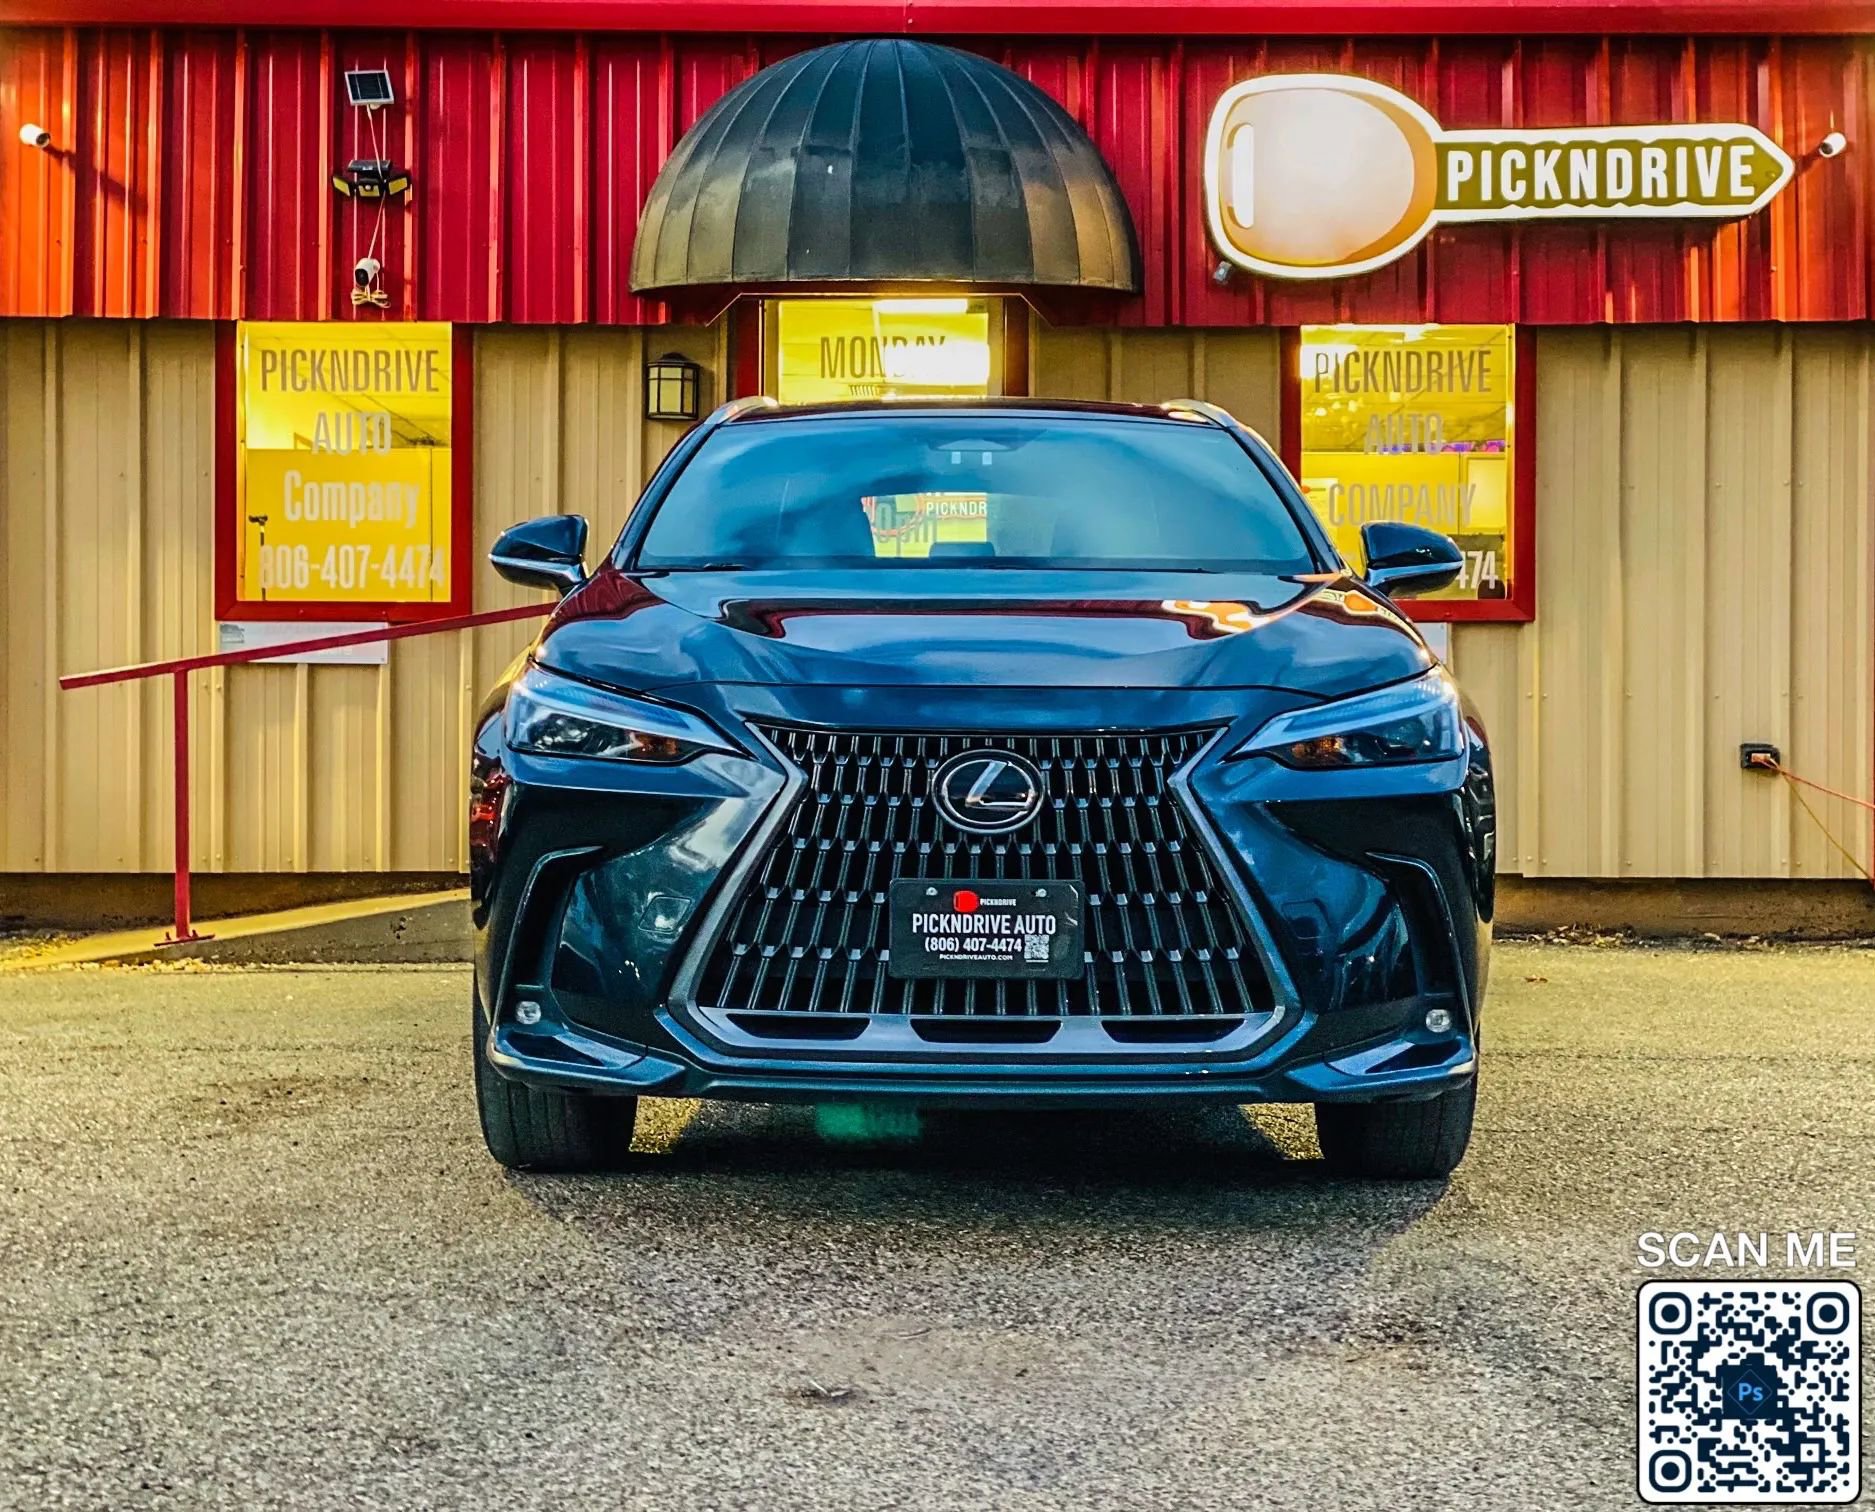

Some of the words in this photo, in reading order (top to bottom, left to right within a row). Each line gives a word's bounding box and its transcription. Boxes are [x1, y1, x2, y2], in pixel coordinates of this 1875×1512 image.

[1447, 145, 1755, 202] PICKNDRIVE
[260, 349, 440, 392] PICKNDRIVE
[820, 335, 946, 379] MON
[1314, 350, 1491, 393] PICKNDRIVE
[311, 411, 393, 456] AUTO
[1364, 411, 1444, 456] AUTO
[283, 470, 420, 528] Company
[1328, 483, 1476, 527] COMPANY
[259, 544, 446, 590] 806-407-4474
[912, 913, 1011, 934] PICKNDRIVE
[1014, 914, 1056, 935] AUTO
[925, 937, 959, 952] (806)
[963, 938, 1022, 952] 407-4474
